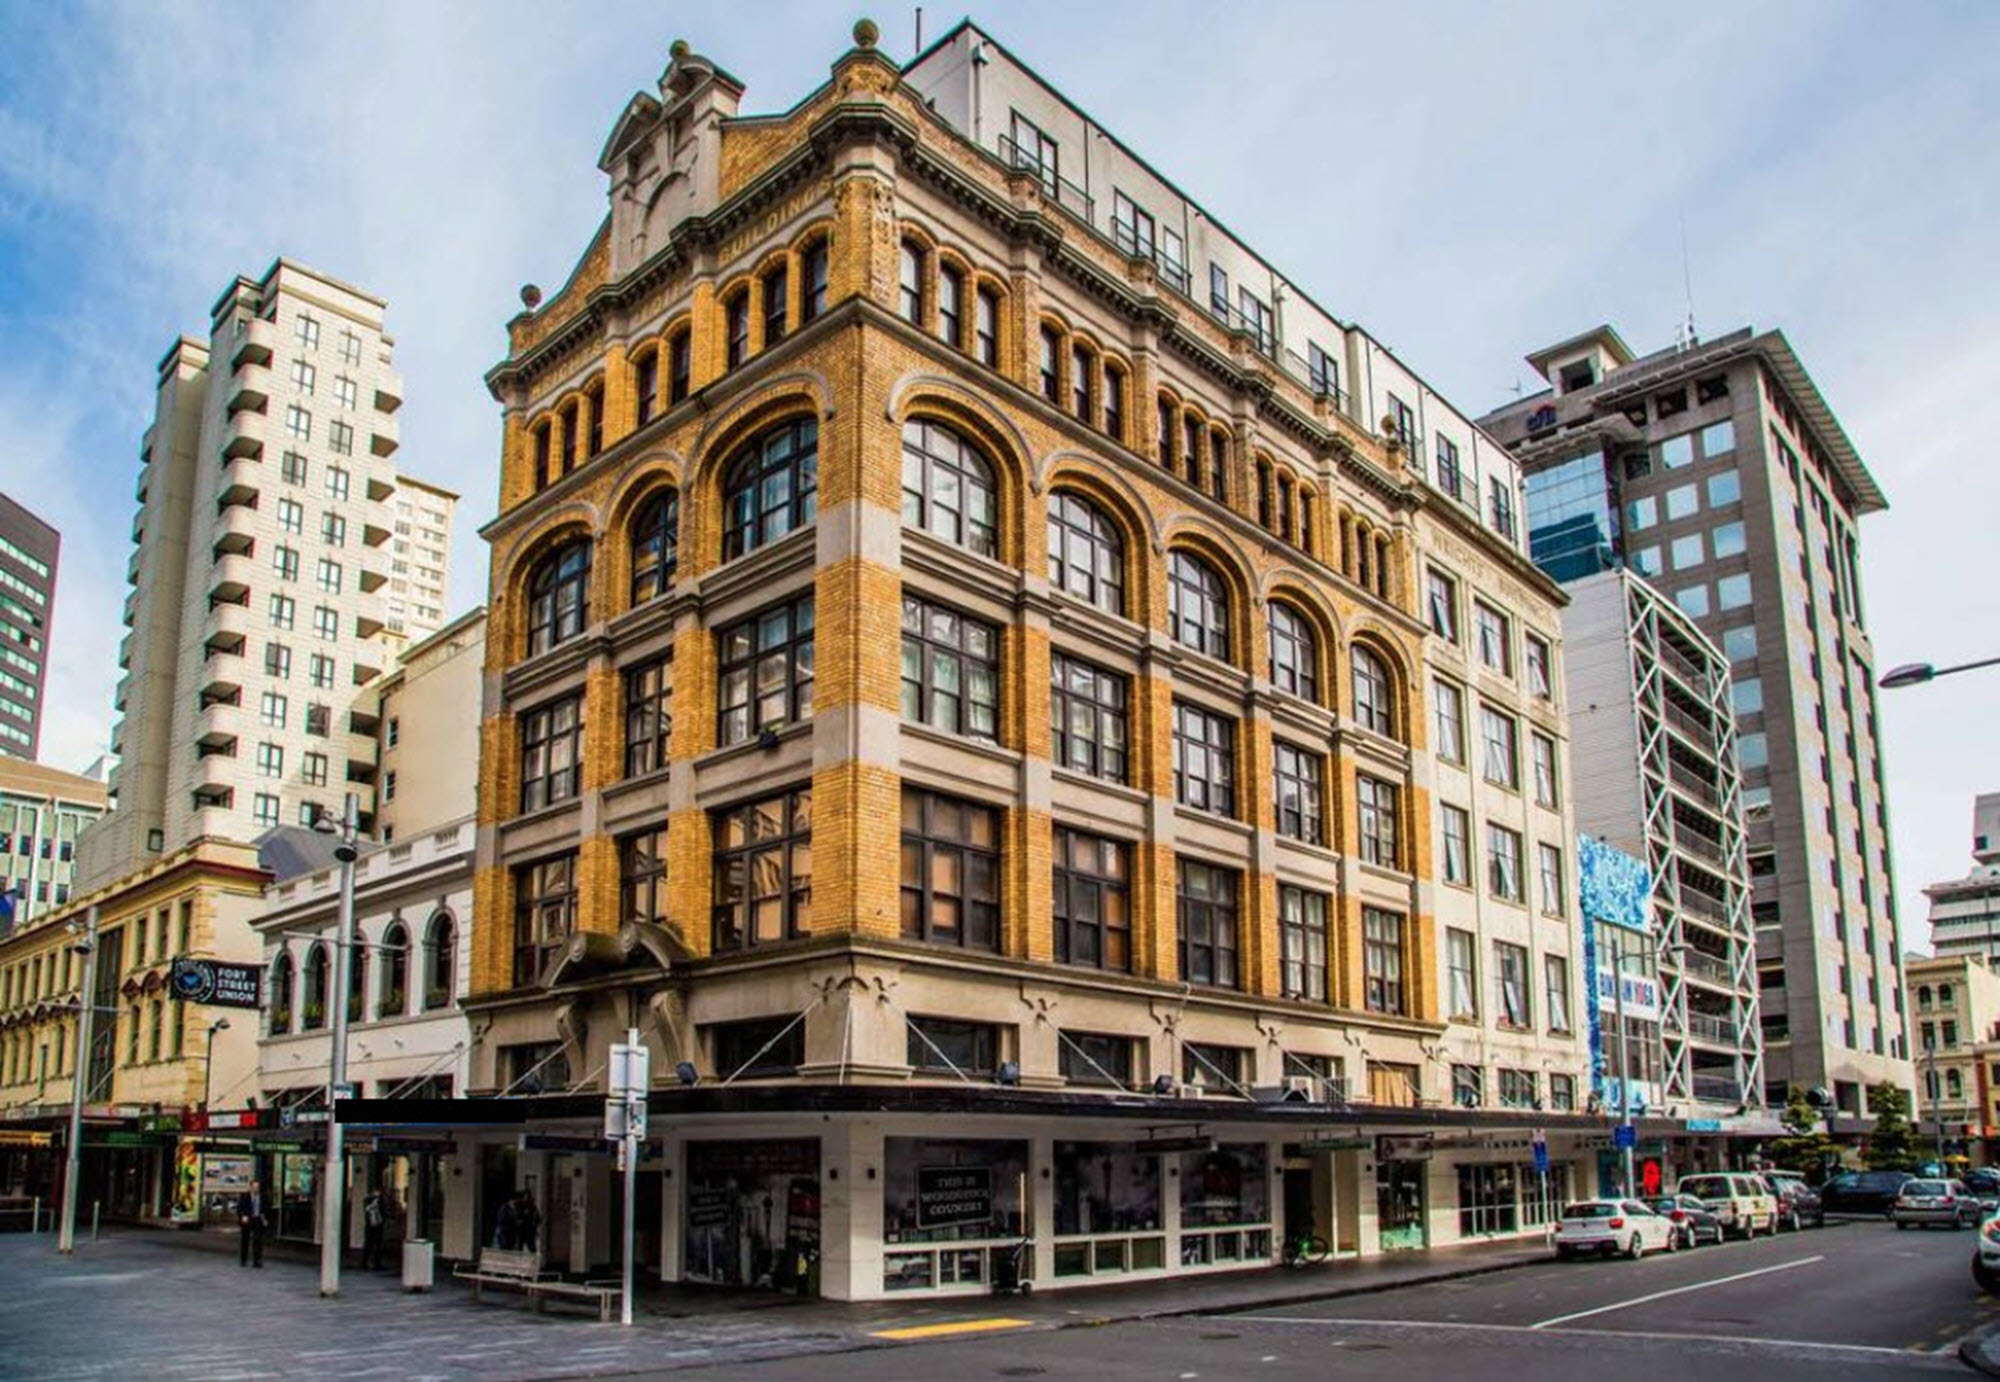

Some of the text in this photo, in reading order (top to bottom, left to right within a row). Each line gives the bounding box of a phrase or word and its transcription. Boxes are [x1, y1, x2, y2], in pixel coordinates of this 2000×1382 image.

[217, 967, 247, 980] FORT
[217, 979, 257, 991] STREET
[216, 990, 255, 1001] UNION
